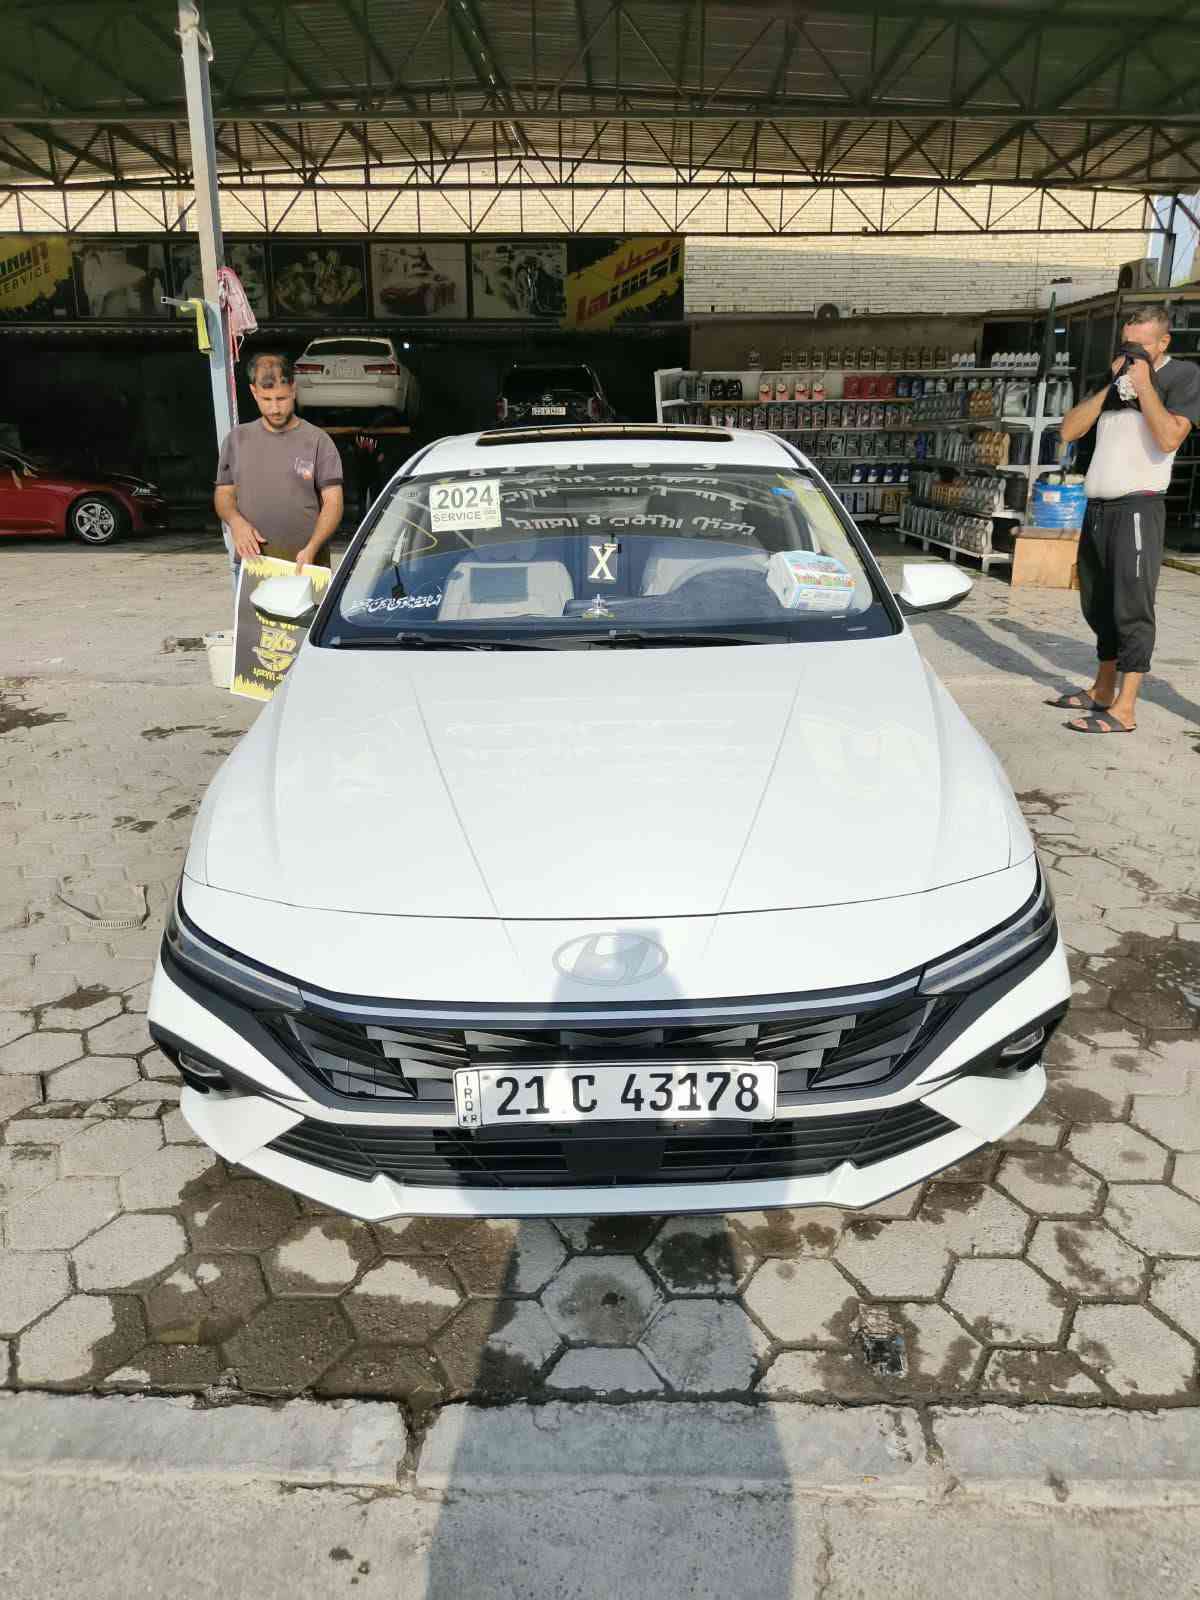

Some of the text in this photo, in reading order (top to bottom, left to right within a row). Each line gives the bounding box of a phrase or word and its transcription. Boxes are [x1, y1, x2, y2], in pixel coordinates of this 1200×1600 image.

[0, 262, 51, 297] ERVICE
[437, 484, 493, 510] 2024
[432, 511, 481, 522] SERVICE
[495, 1072, 759, 1116] 21 C 43178
